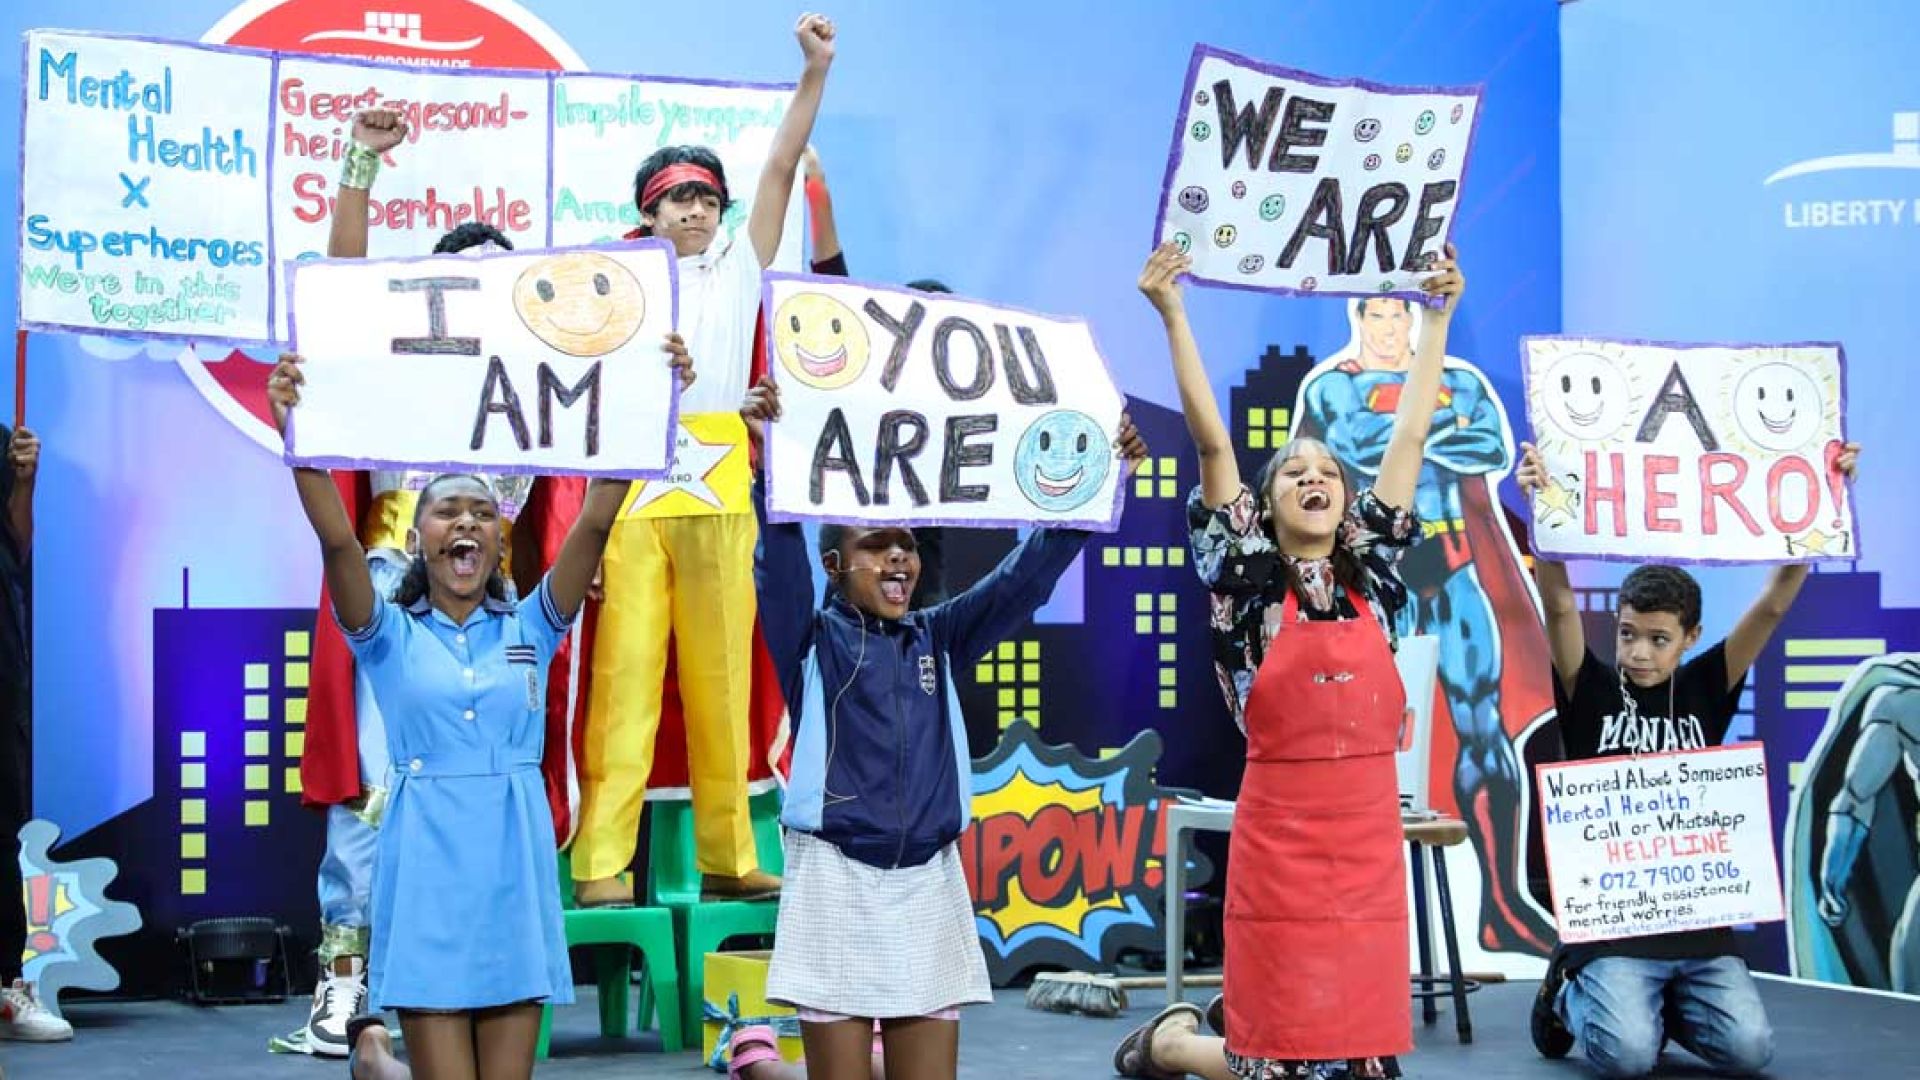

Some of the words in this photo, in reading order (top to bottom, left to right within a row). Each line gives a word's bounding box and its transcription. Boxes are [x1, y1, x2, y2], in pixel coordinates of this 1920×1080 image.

[39, 47, 172, 115] Mental
[128, 113, 257, 178] Health
[1213, 79, 1337, 174] WE
[293, 172, 532, 232] Sperhelde
[1276, 177, 1457, 276] ARE
[1784, 199, 1906, 228] LIBERTY
[27, 214, 263, 270] Superheroes
[88, 293, 236, 329] together
[180, 271, 241, 300] this
[389, 277, 481, 355] I
[863, 298, 1058, 405] YOU
[470, 355, 602, 458] AM
[1636, 360, 1721, 451] A
[809, 407, 998, 506] ARE
[1584, 439, 1848, 537] HERO!
[1598, 712, 1706, 753] MONACO
[1546, 796, 1612, 824] Mental
[1621, 789, 1690, 817] Health
[1547, 769, 1621, 799] Worried
[1626, 766, 1672, 790] About
[1678, 761, 1765, 784] Someones
[1583, 820, 1621, 841] Call
[1632, 823, 1652, 836] or
[1657, 809, 1746, 833] WhatsApp
[1607, 831, 1733, 864] HELPLINE
[1597, 891, 1658, 911] friendly
[1600, 870, 1639, 891] 072
[1643, 864, 1695, 887] 7900
[1702, 860, 1740, 882] 506
[1569, 912, 1625, 930] mental
